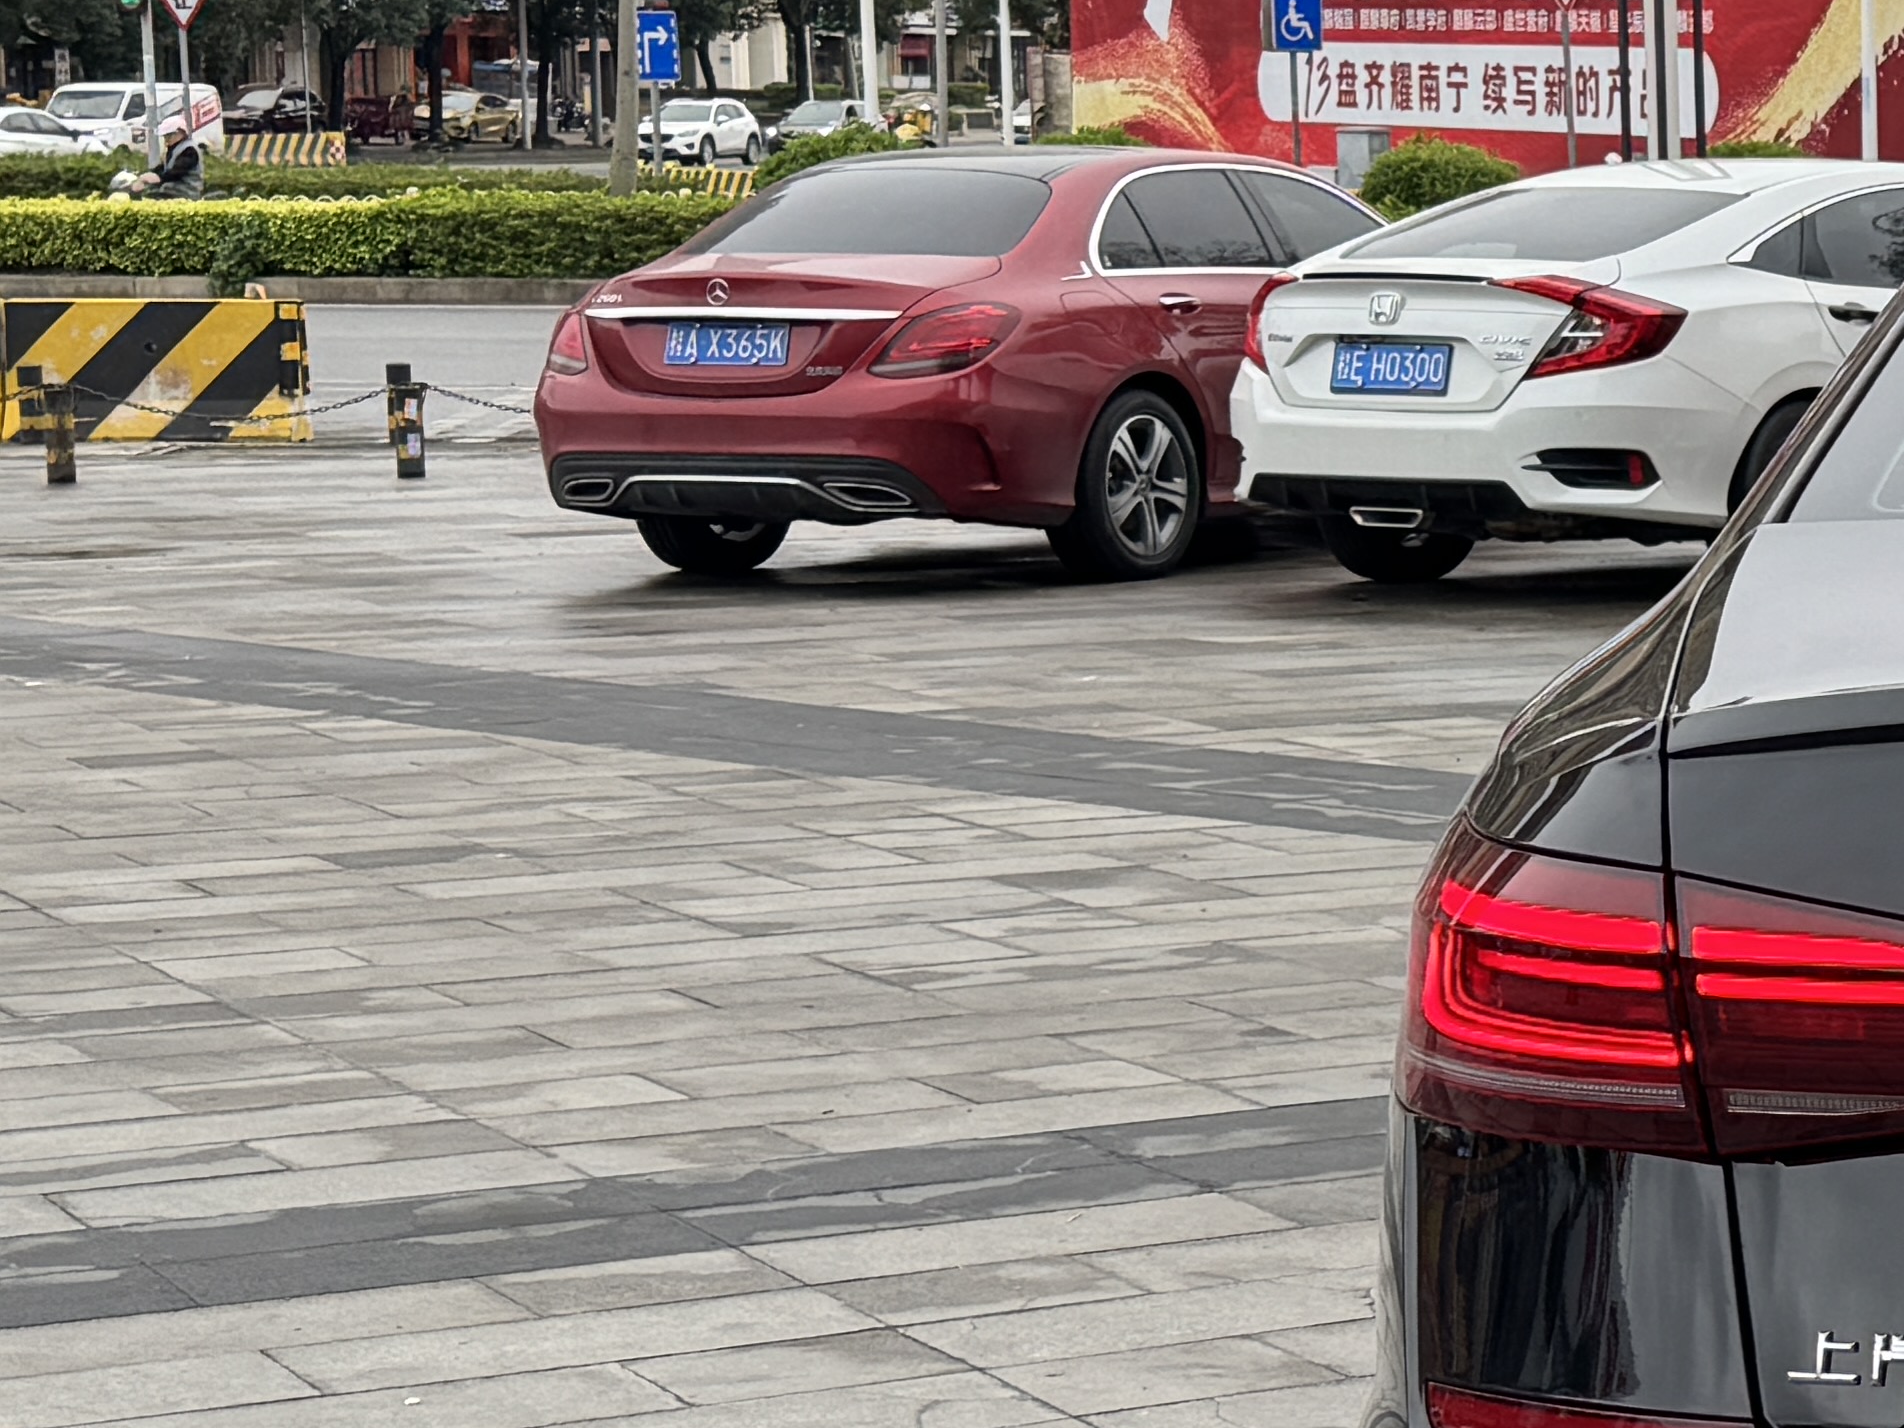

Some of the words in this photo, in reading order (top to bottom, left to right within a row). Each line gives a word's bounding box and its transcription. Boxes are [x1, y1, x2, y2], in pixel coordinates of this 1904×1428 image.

[1482, 61, 1650, 120] 续写新的产
